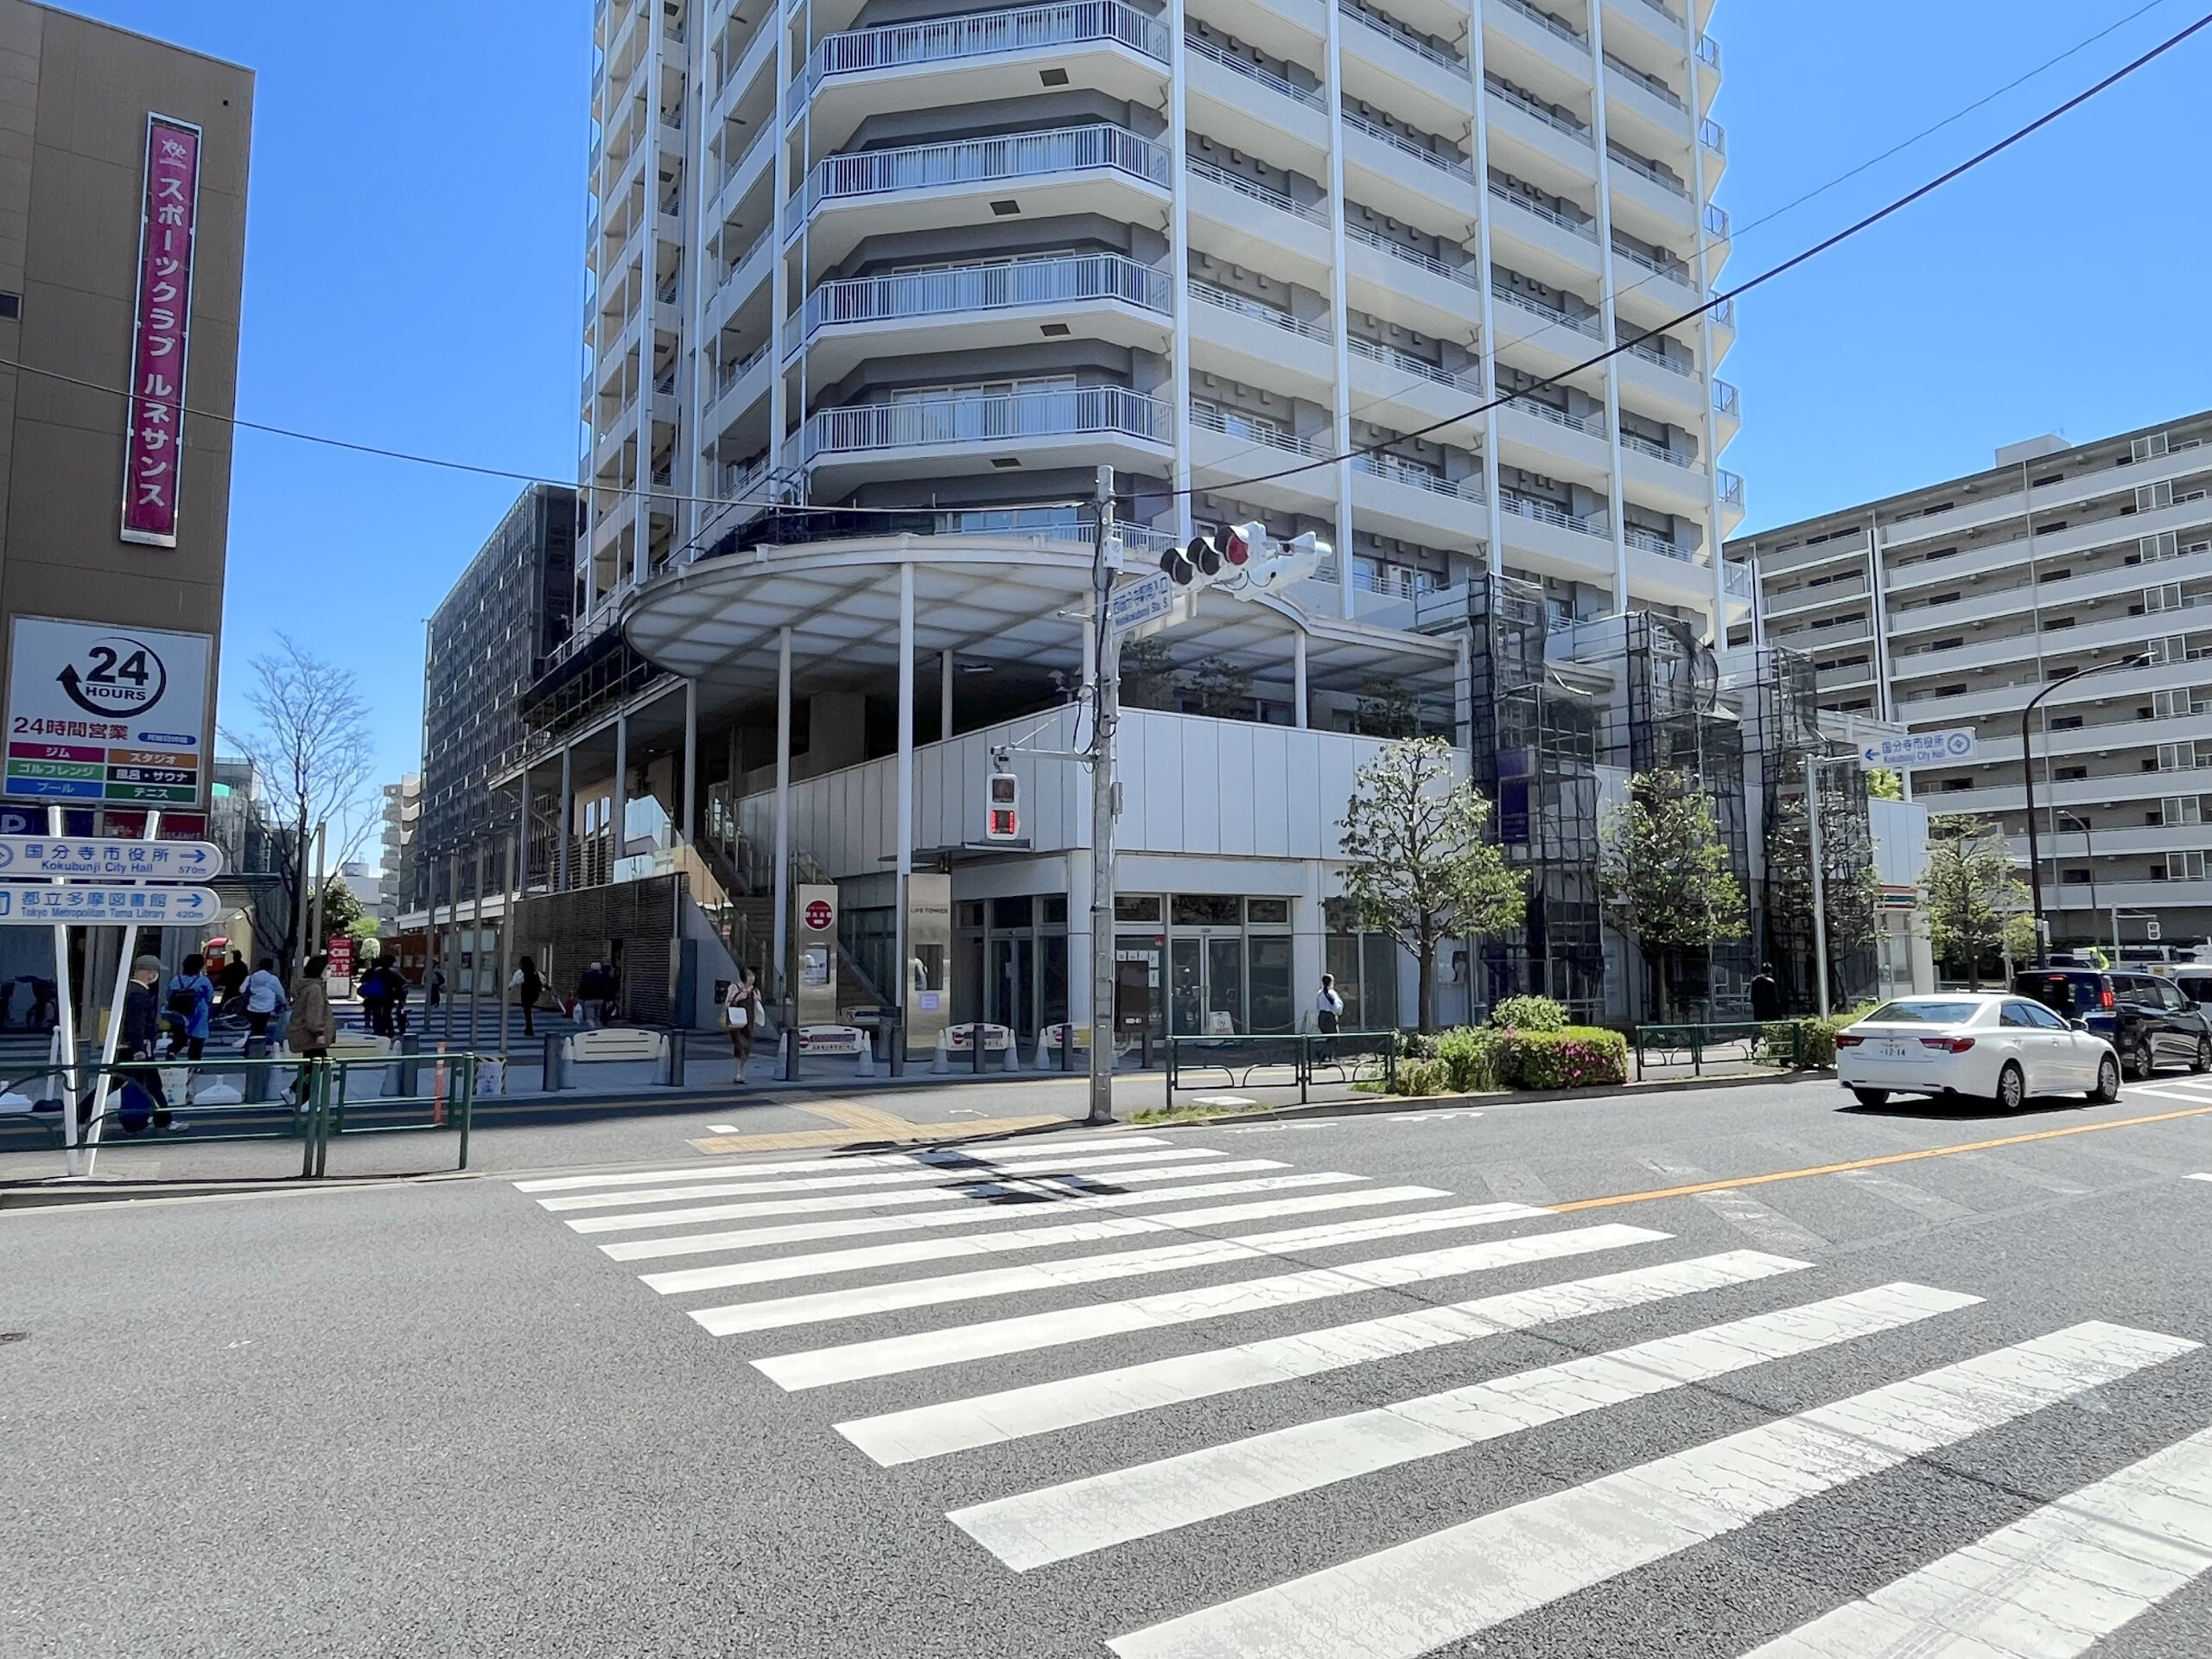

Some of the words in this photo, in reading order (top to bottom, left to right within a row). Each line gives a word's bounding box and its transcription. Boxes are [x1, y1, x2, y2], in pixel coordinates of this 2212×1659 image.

[149, 176, 185, 357] スポーツクラブ
[138, 372, 172, 508] ルネサンス
[86, 646, 149, 686] 24
[86, 686, 146, 701] HOURS
[14, 716, 129, 741] 24時間営業
[1882, 734, 1944, 754] 国分寺市役所
[46, 747, 70, 758] ジム
[130, 752, 176, 765] スタジオ
[1916, 750, 1930, 760] City
[19, 762, 94, 777] ゴルフレンジ
[116, 768, 188, 782] 風呂・サウナ
[37, 782, 74, 793] プール
[134, 787, 168, 798] テニス
[1, 814, 27, 834] P
[25, 844, 168, 862] 国分寺市役所
[41, 860, 100, 873] Kokubunji
[105, 863, 126, 874] City
[131, 864, 153, 873] Hall
[179, 866, 207, 874] 570m
[22, 891, 168, 908] 都立多摩図書館
[22, 907, 48, 918] Tokyo
[52, 907, 105, 918] Metropolitan
[111, 908, 132, 918] Tama
[137, 909, 165, 919] Library
[176, 910, 204, 918] 420m
